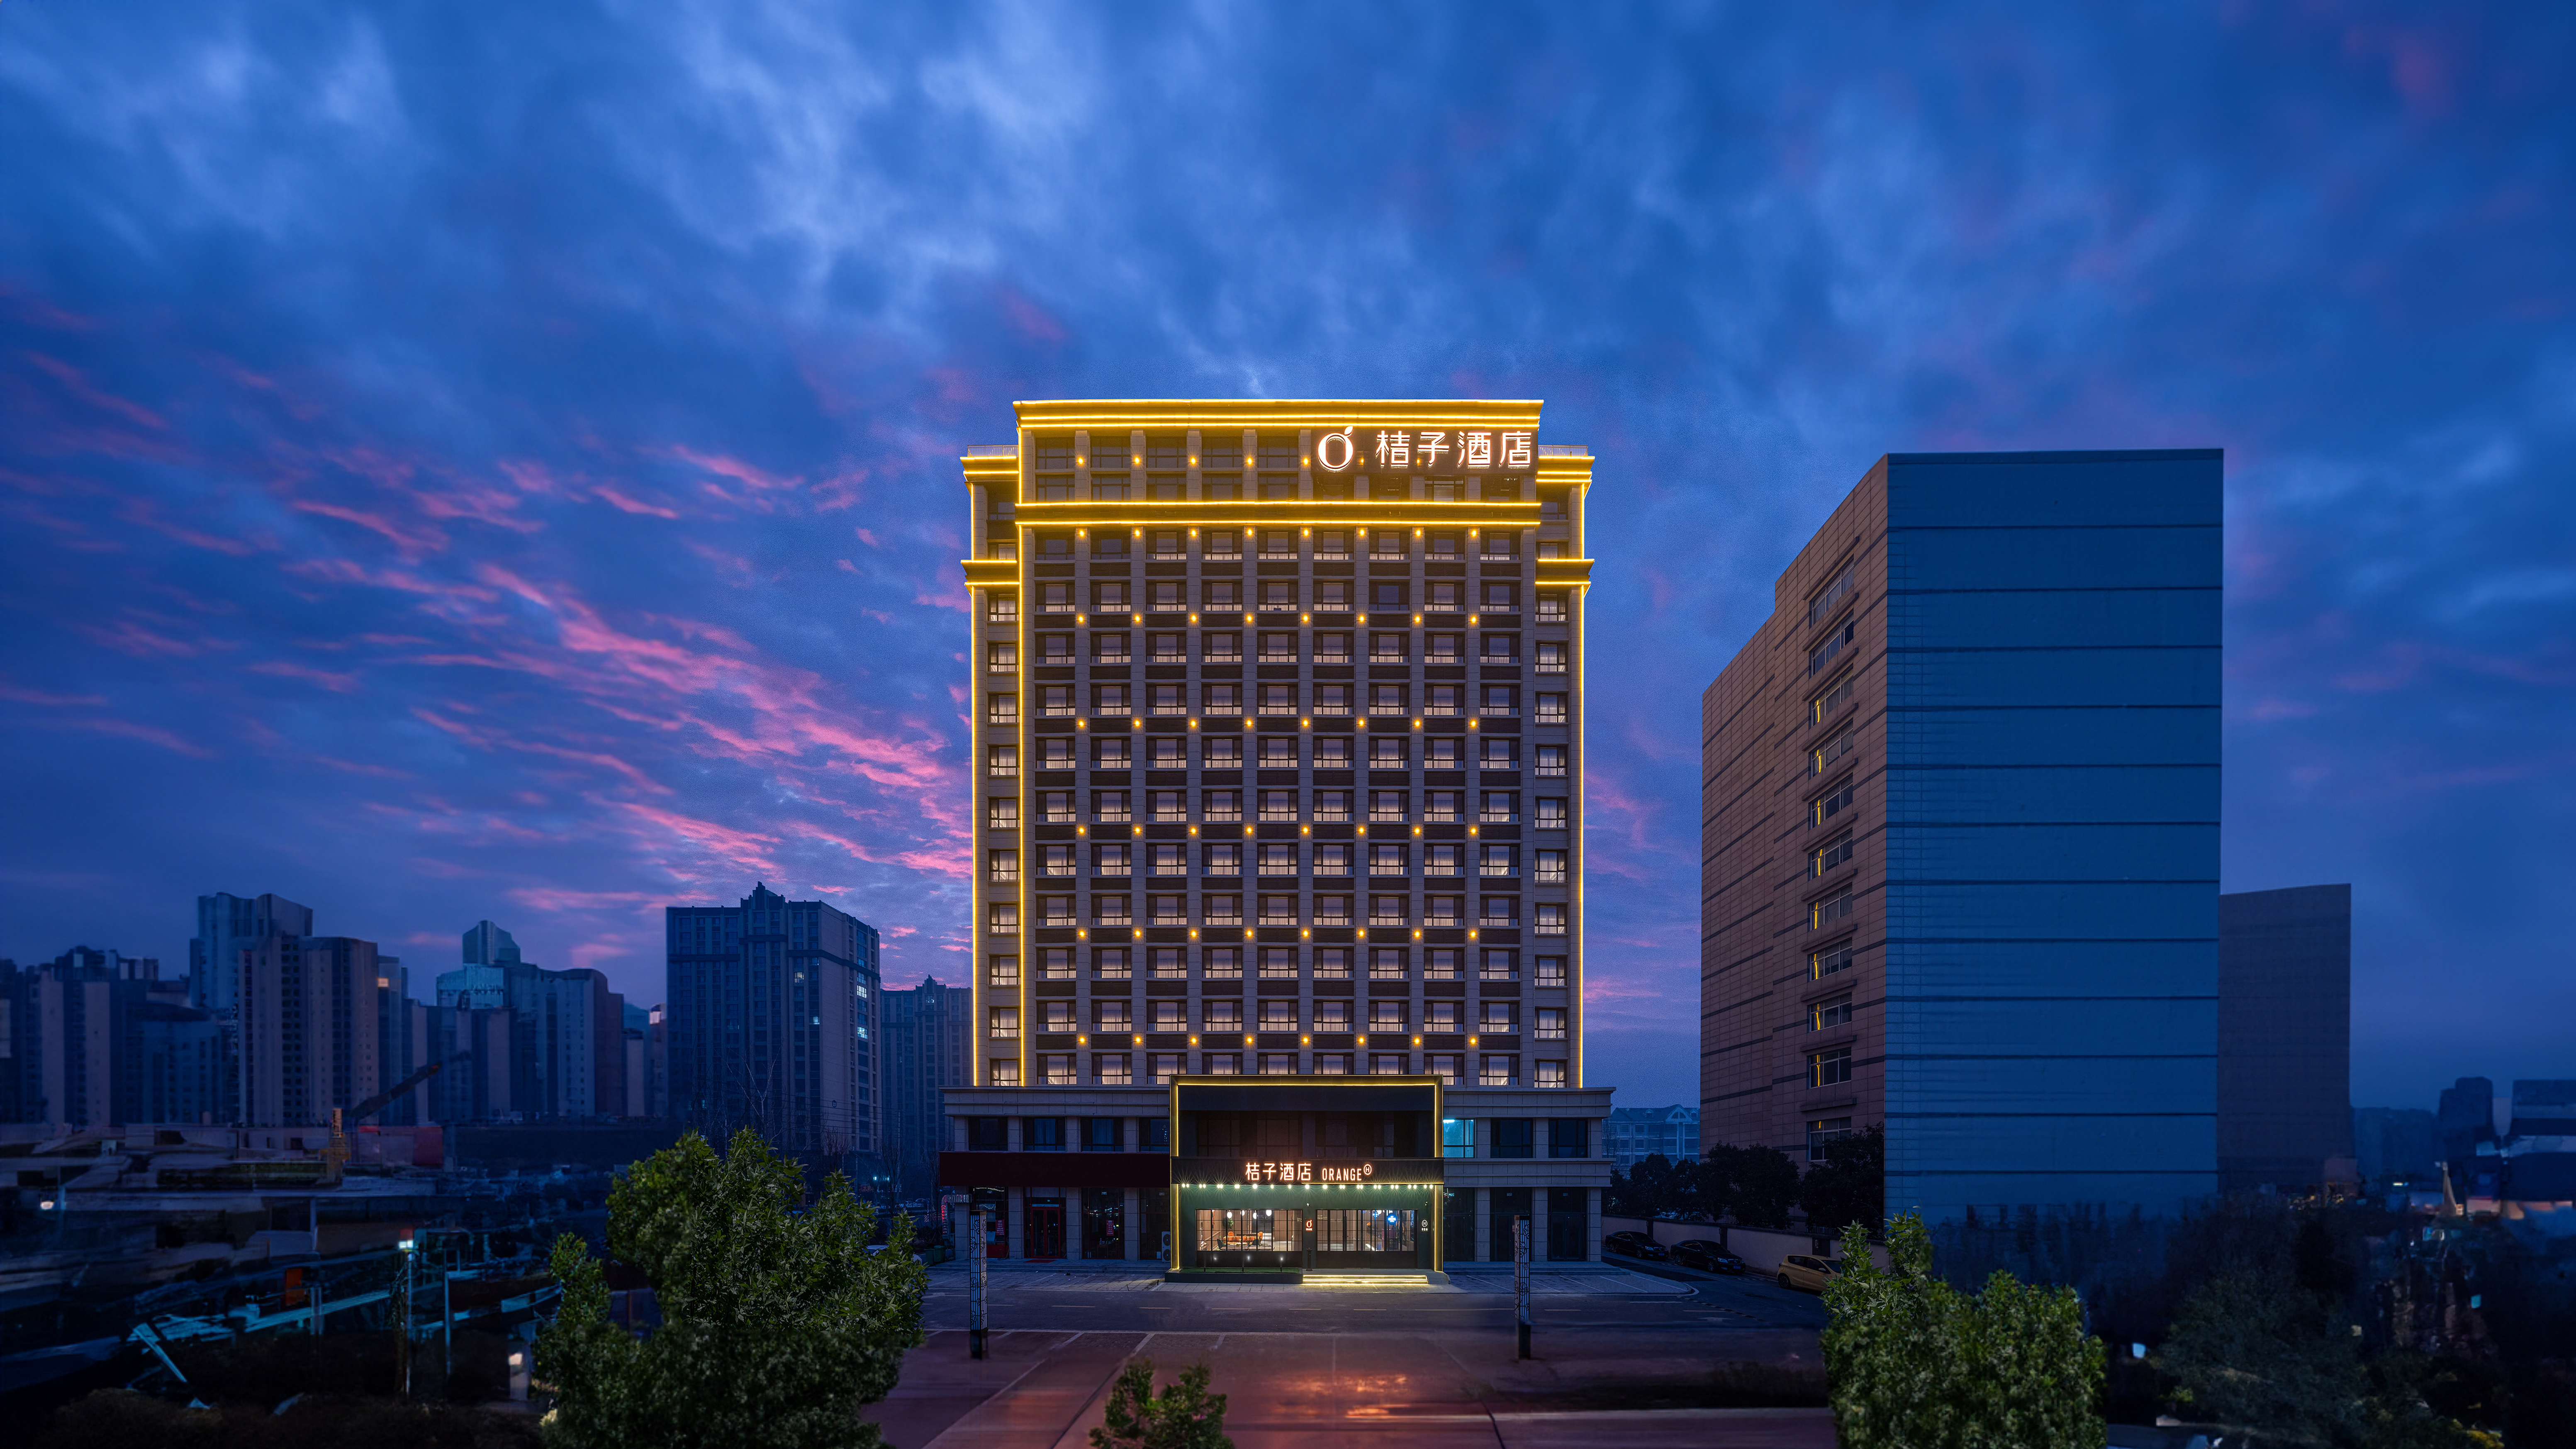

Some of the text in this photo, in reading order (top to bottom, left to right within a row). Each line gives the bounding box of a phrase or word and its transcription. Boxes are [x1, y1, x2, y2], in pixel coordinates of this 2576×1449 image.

[1376, 430, 1531, 468] 桔子酒店
[1245, 1162, 1311, 1181] 桔子酒店
[1322, 1168, 1362, 1181] ORANGE
